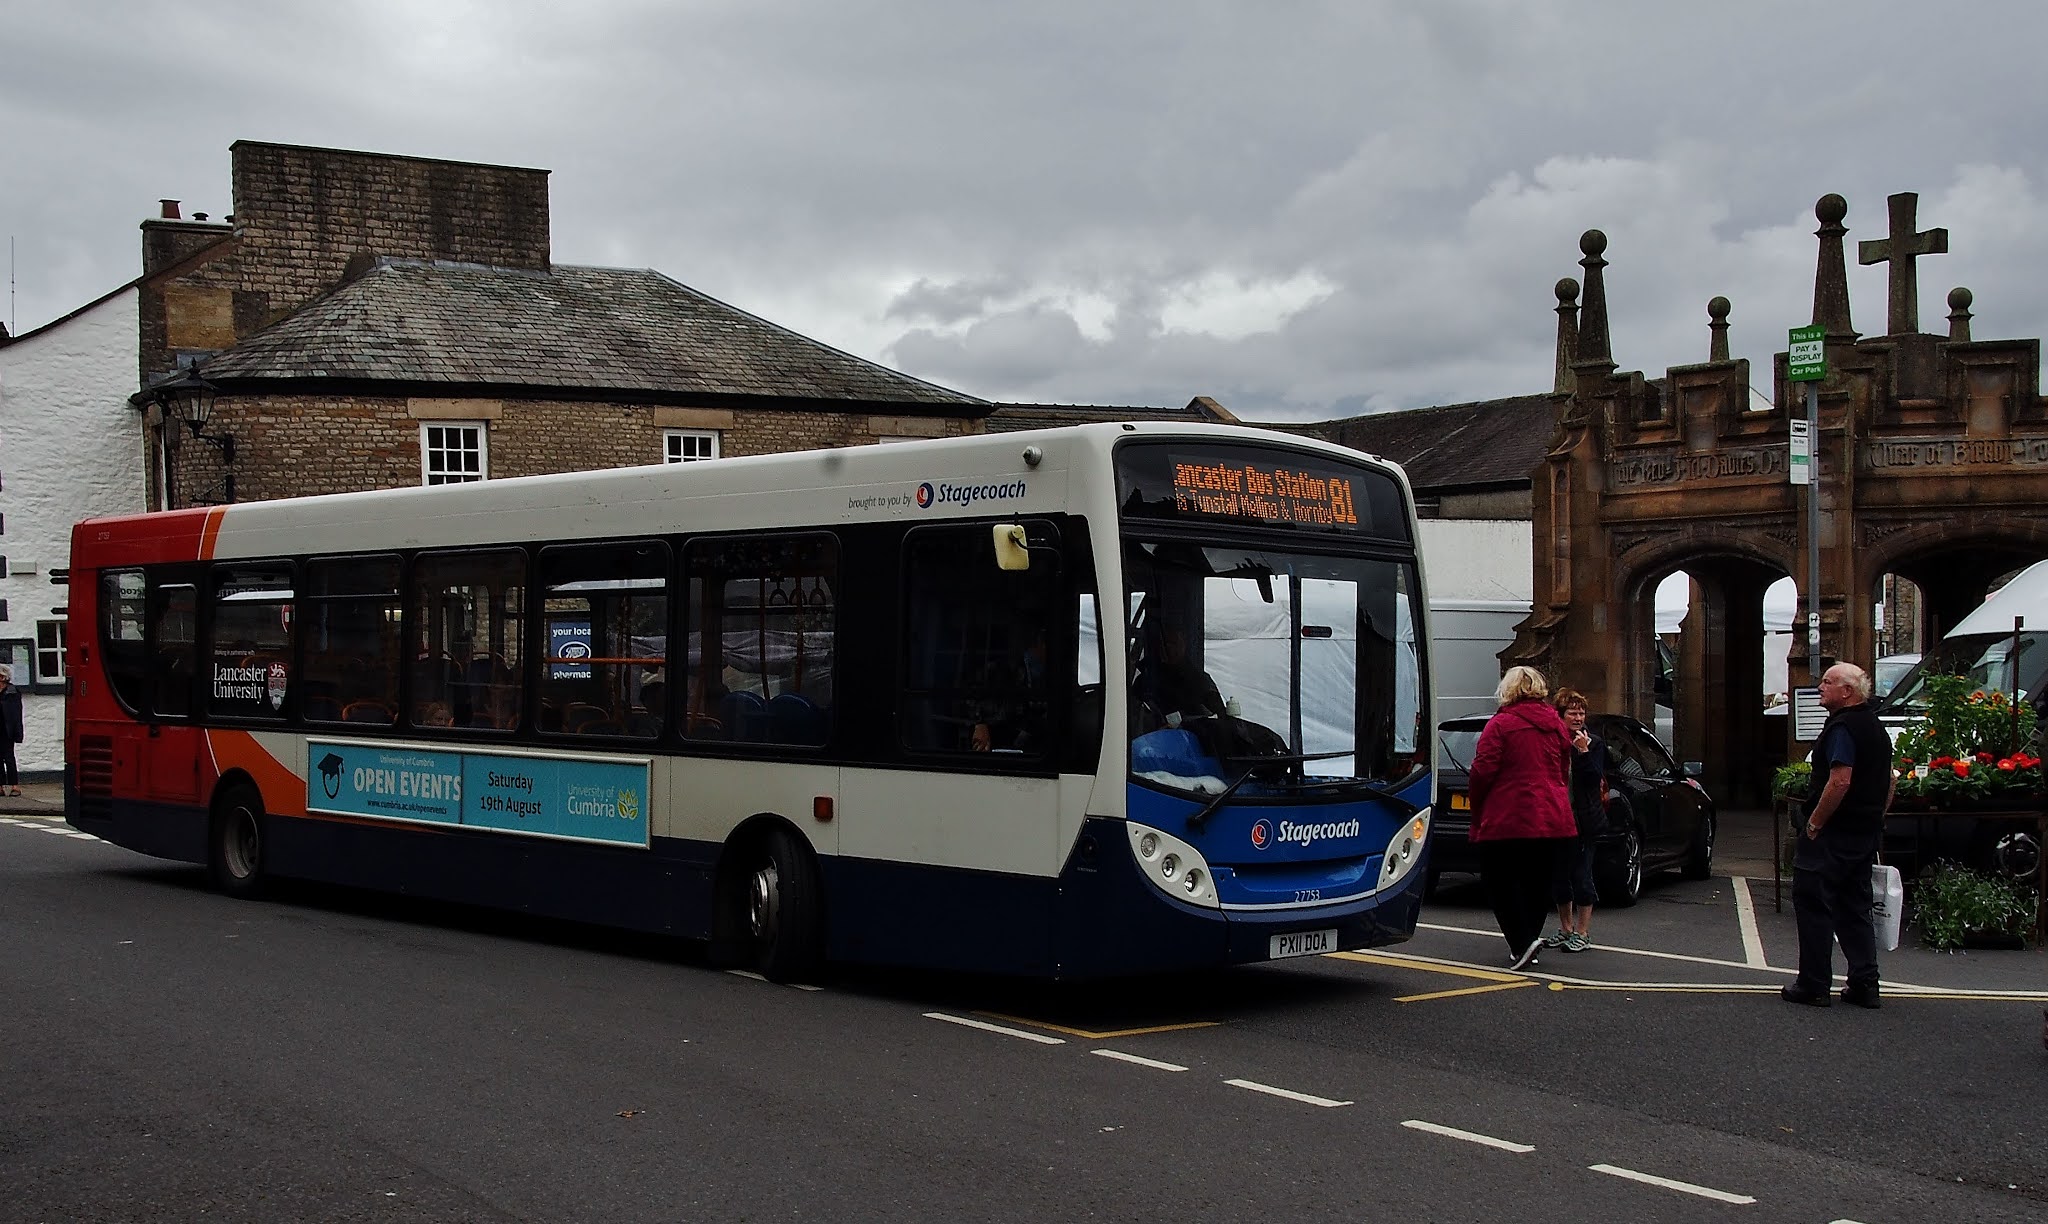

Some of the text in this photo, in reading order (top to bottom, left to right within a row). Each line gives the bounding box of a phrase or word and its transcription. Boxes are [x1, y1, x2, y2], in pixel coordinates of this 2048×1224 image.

[1807, 331, 1815, 339] is
[1790, 352, 1822, 363] DISPLAY
[1795, 344, 1810, 353] PAY
[1805, 366, 1821, 374] Park
[848, 479, 1027, 511] brought to you by Stagecoach
[1173, 463, 1358, 525] ancaster Bus Station 81
[1189, 489, 1239, 516] Tunstall
[1240, 494, 1279, 520] Melling
[1280, 498, 1292, 521] &
[1293, 499, 1333, 524] Hornby
[552, 626, 592, 638] your loca
[213, 662, 267, 682] Lancaster
[553, 671, 592, 680] pharmac
[213, 681, 265, 704] University
[353, 767, 462, 802] OPEN EVENTS
[487, 771, 534, 795] Saturday
[567, 783, 616, 799] University of
[480, 795, 542, 819] 19th August
[567, 795, 616, 819] Cumbria
[1277, 817, 1360, 847] Stagecoach
[1294, 889, 1321, 903] 27753
[1304, 932, 1328, 951] DOA
